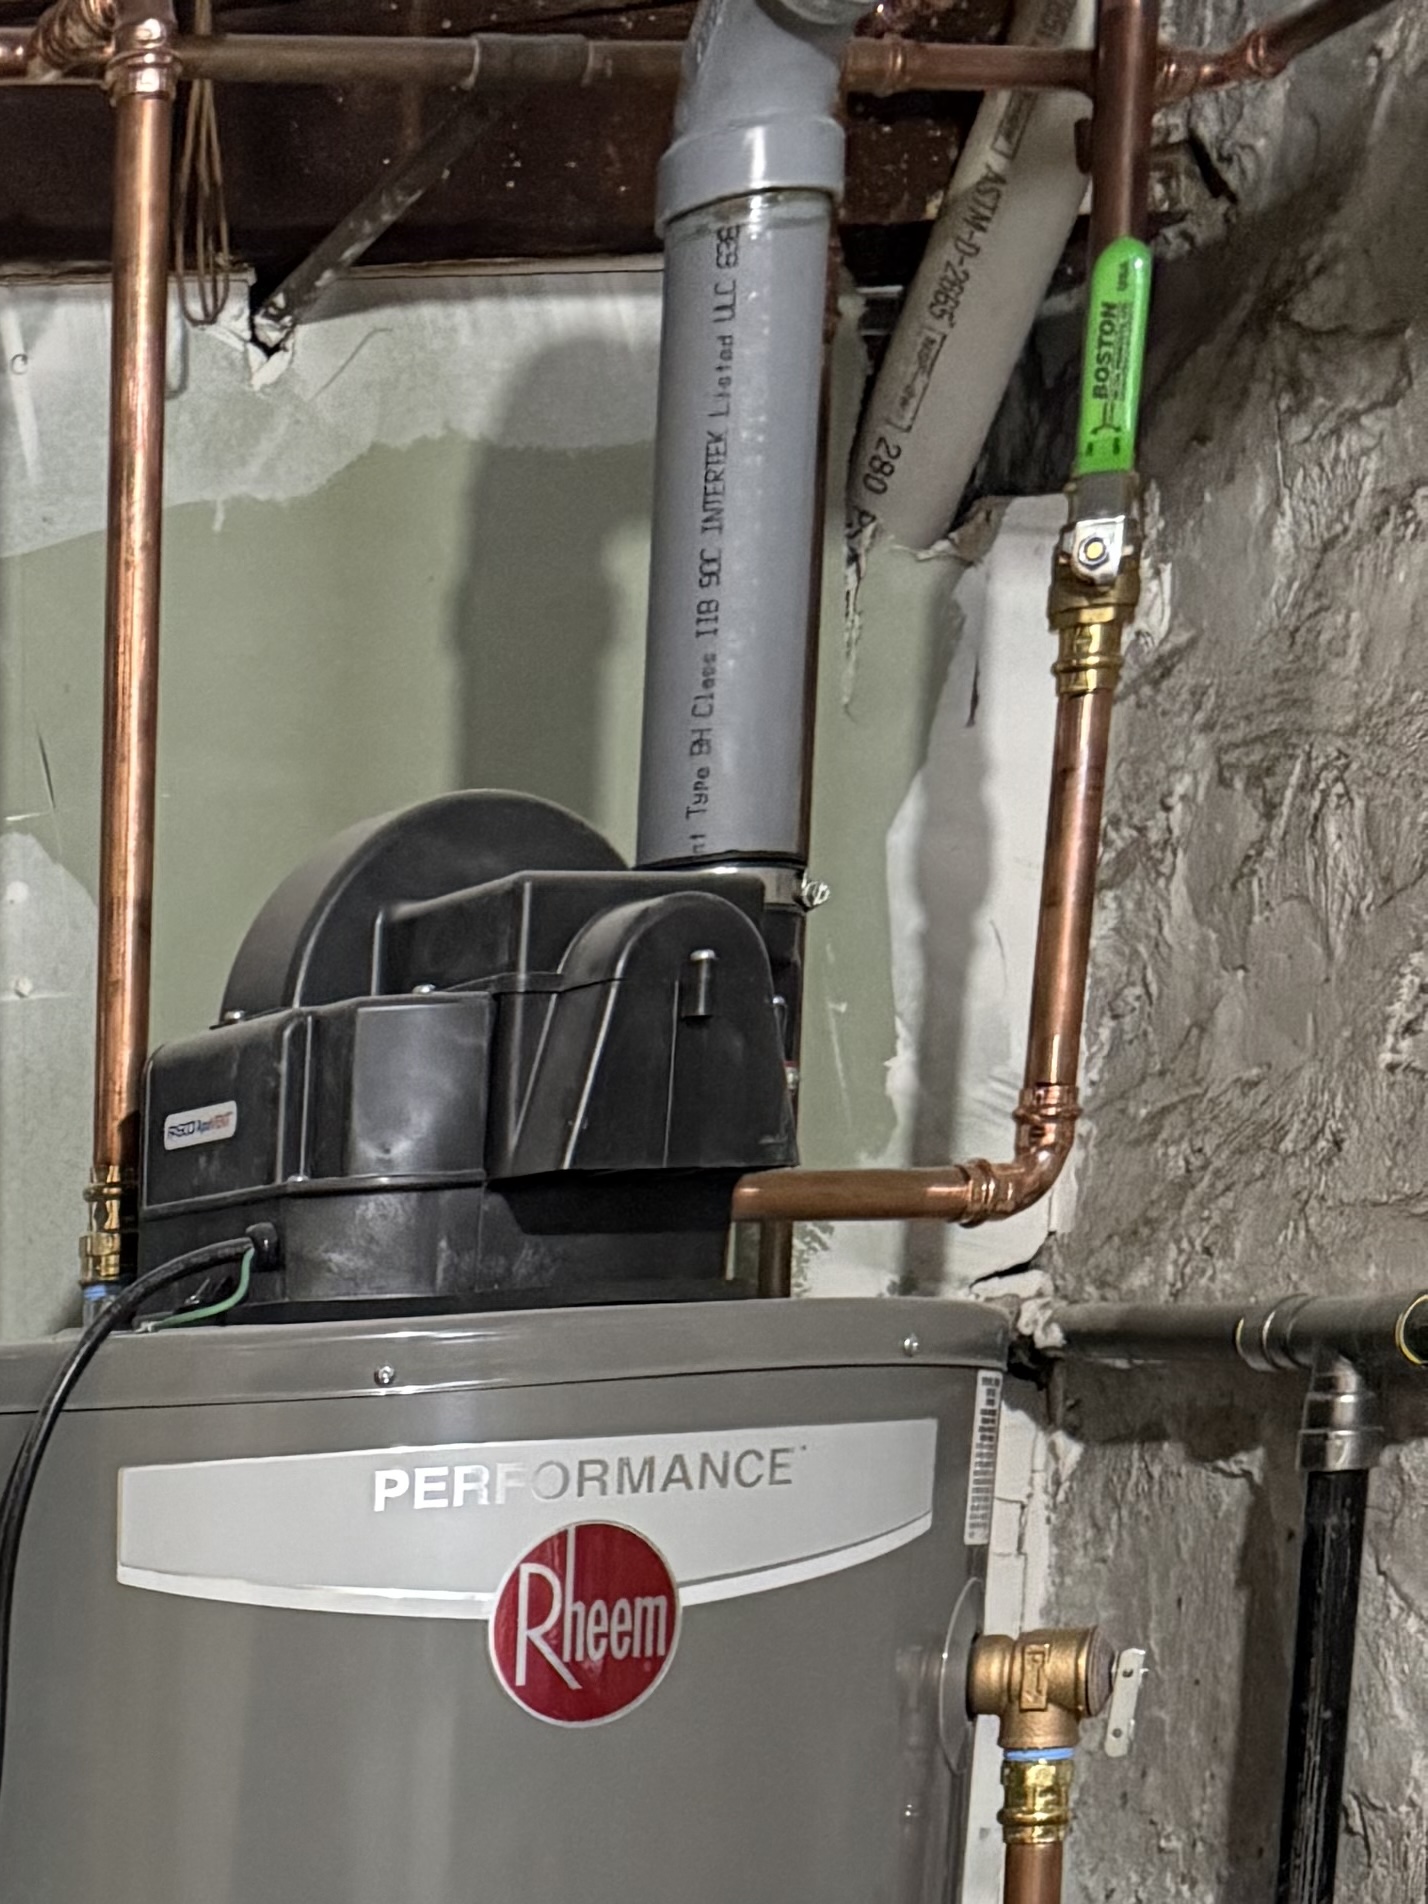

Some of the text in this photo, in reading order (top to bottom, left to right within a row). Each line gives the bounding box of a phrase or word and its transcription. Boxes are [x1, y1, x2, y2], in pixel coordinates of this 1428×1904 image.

[712, 281, 736, 321] ULC
[1092, 301, 1116, 399] BOSTON
[703, 431, 728, 534] INTERTEK
[867, 436, 902, 495] 280
[690, 728, 712, 756] BH
[686, 767, 712, 819] Type
[374, 1442, 794, 1513] PERFORMANCE
[516, 1527, 667, 1691] Rheem
